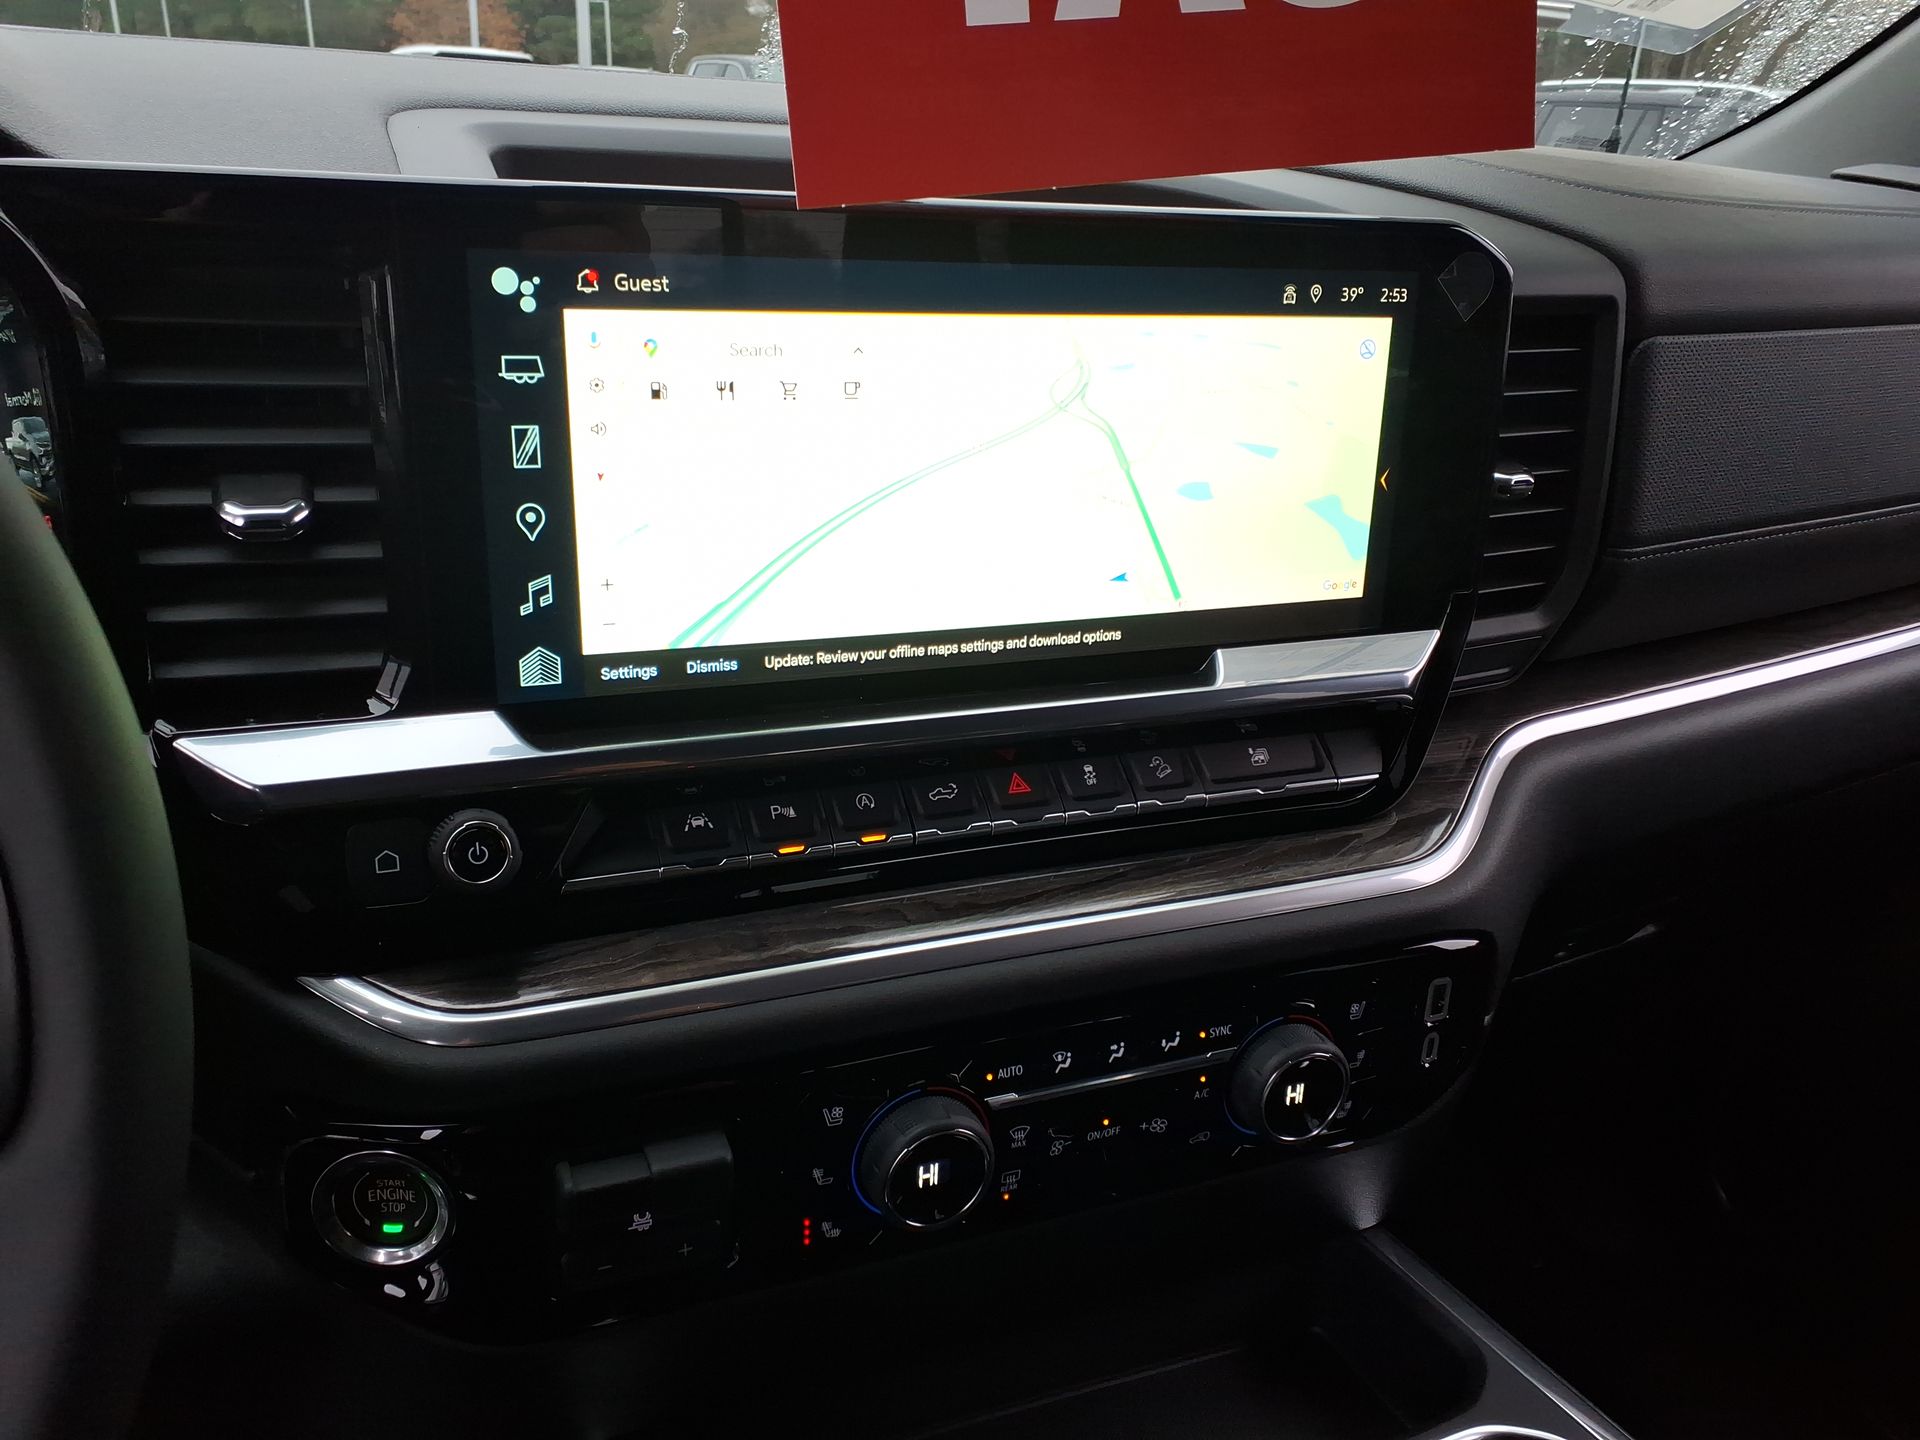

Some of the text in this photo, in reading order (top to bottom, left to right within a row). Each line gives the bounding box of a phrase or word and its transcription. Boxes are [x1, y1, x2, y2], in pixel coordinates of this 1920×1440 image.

[614, 273, 670, 293] Guest
[1380, 288, 1408, 303] 2:53
[729, 342, 784, 358] Search
[1322, 578, 1358, 592] Google
[764, 629, 1122, 671] Update: Review your offline maps settings and download options
[600, 663, 658, 681] Settings
[686, 658, 738, 674] Dismiss
[1209, 1024, 1233, 1039] SYNC
[997, 1064, 1023, 1080] AUTO
[1194, 1088, 1210, 1100] A/C
[1285, 1082, 1305, 1106] HI
[1086, 1126, 1121, 1142] ON/OFF
[1010, 1139, 1027, 1150] MAX
[917, 1161, 939, 1189] HI
[376, 1179, 405, 1187] START
[1000, 1183, 1019, 1193] REAR
[368, 1188, 416, 1203] ENGINE
[380, 1203, 406, 1212] STOP
